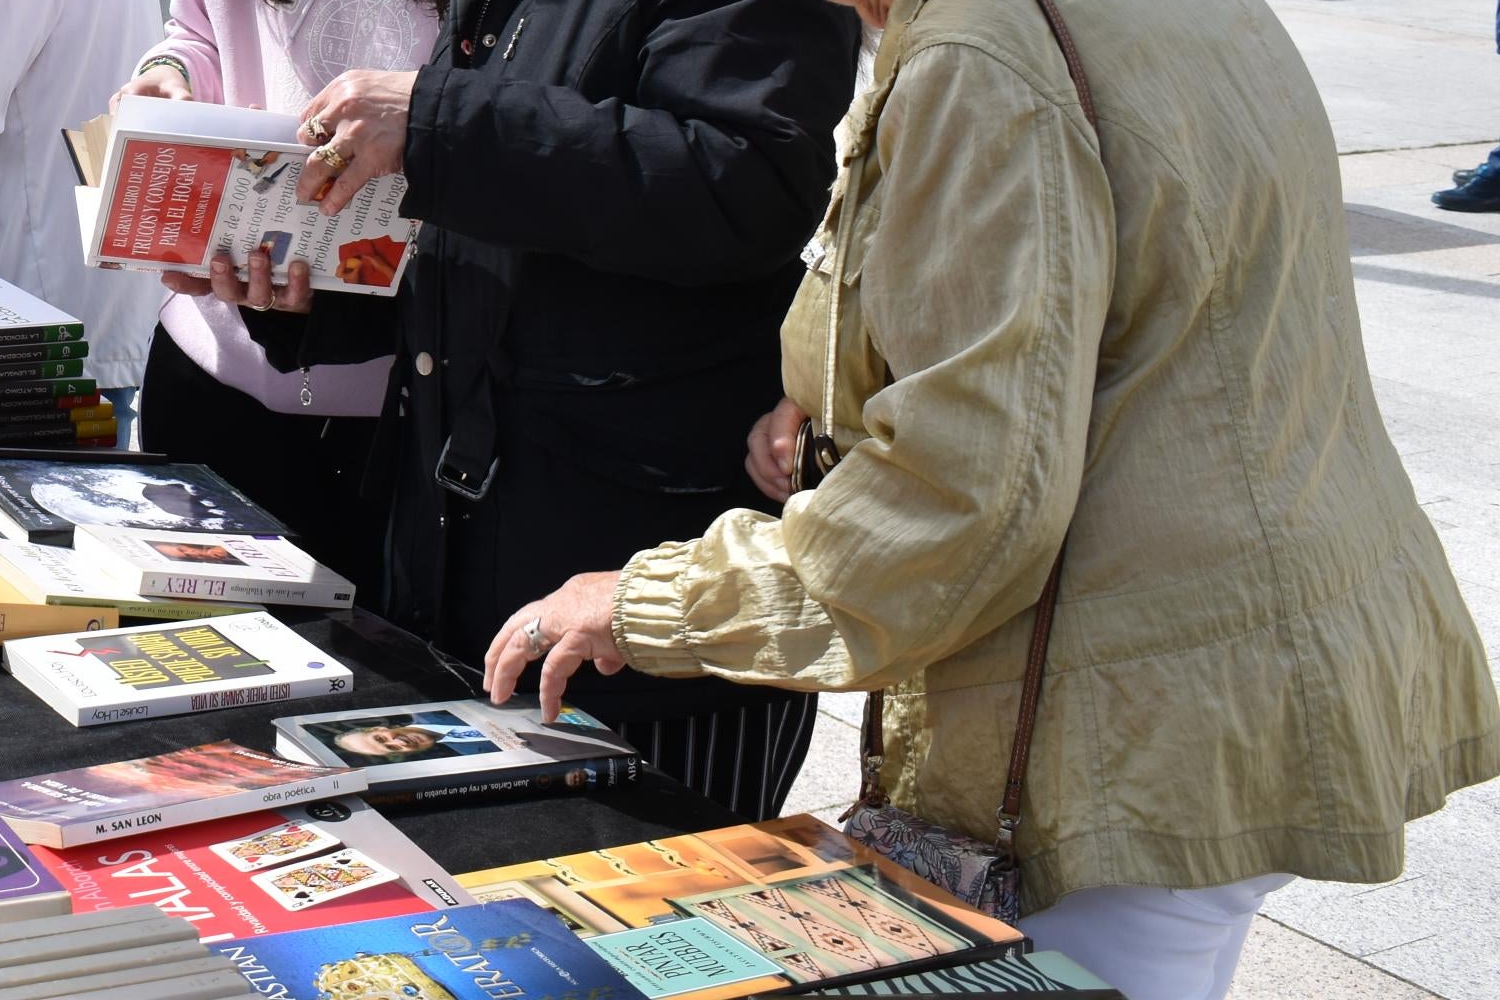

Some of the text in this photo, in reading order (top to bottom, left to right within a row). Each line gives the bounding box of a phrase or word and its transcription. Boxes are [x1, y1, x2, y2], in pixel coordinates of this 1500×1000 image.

[113, 152, 149, 247] EL GRAN LIBRO DE LOS
[131, 147, 177, 255] TRUCOS Y CONSEJOS
[227, 177, 251, 212] 2.000
[268, 160, 303, 224] ingeniosas
[158, 163, 199, 246] PARA EL HOGAR
[189, 181, 215, 234] CASSANDRA KENT
[222, 213, 240, 230] de
[239, 197, 269, 256] soluciones
[373, 209, 395, 228] del
[292, 210, 320, 258] para los
[307, 212, 341, 272] problemas
[162, 575, 198, 594] REY
[203, 579, 227, 597] EL
[266, 588, 275, 596] de
[276, 588, 290, 597] Luis
[291, 590, 307, 600] José
[173, 627, 242, 659] SU VIDA
[127, 632, 222, 684] PUEDE SANAR
[108, 658, 170, 685] USTED
[190, 691, 208, 711] VIDA
[208, 690, 219, 709] SU
[219, 686, 245, 709] SANAR
[245, 684, 268, 708] PUEDE
[269, 683, 291, 705] USTED
[120, 704, 149, 717] Louise
[626, 757, 637, 782] ABC
[424, 786, 448, 799] pueblo
[448, 786, 459, 795] un
[458, 785, 468, 795] de
[468, 782, 481, 793] rey
[481, 783, 488, 792] el
[513, 778, 530, 789] Juan
[94, 823, 108, 835] M.
[111, 818, 133, 832] SAN
[135, 813, 162, 830] LEON
[262, 789, 282, 803] obra
[284, 785, 316, 801] poética
[193, 870, 231, 901] complicidad
[425, 881, 455, 905] AGUILAR
[234, 904, 269, 935] Rivalidad
[624, 941, 693, 980] PINTAR
[648, 930, 734, 979] MUEBLES
